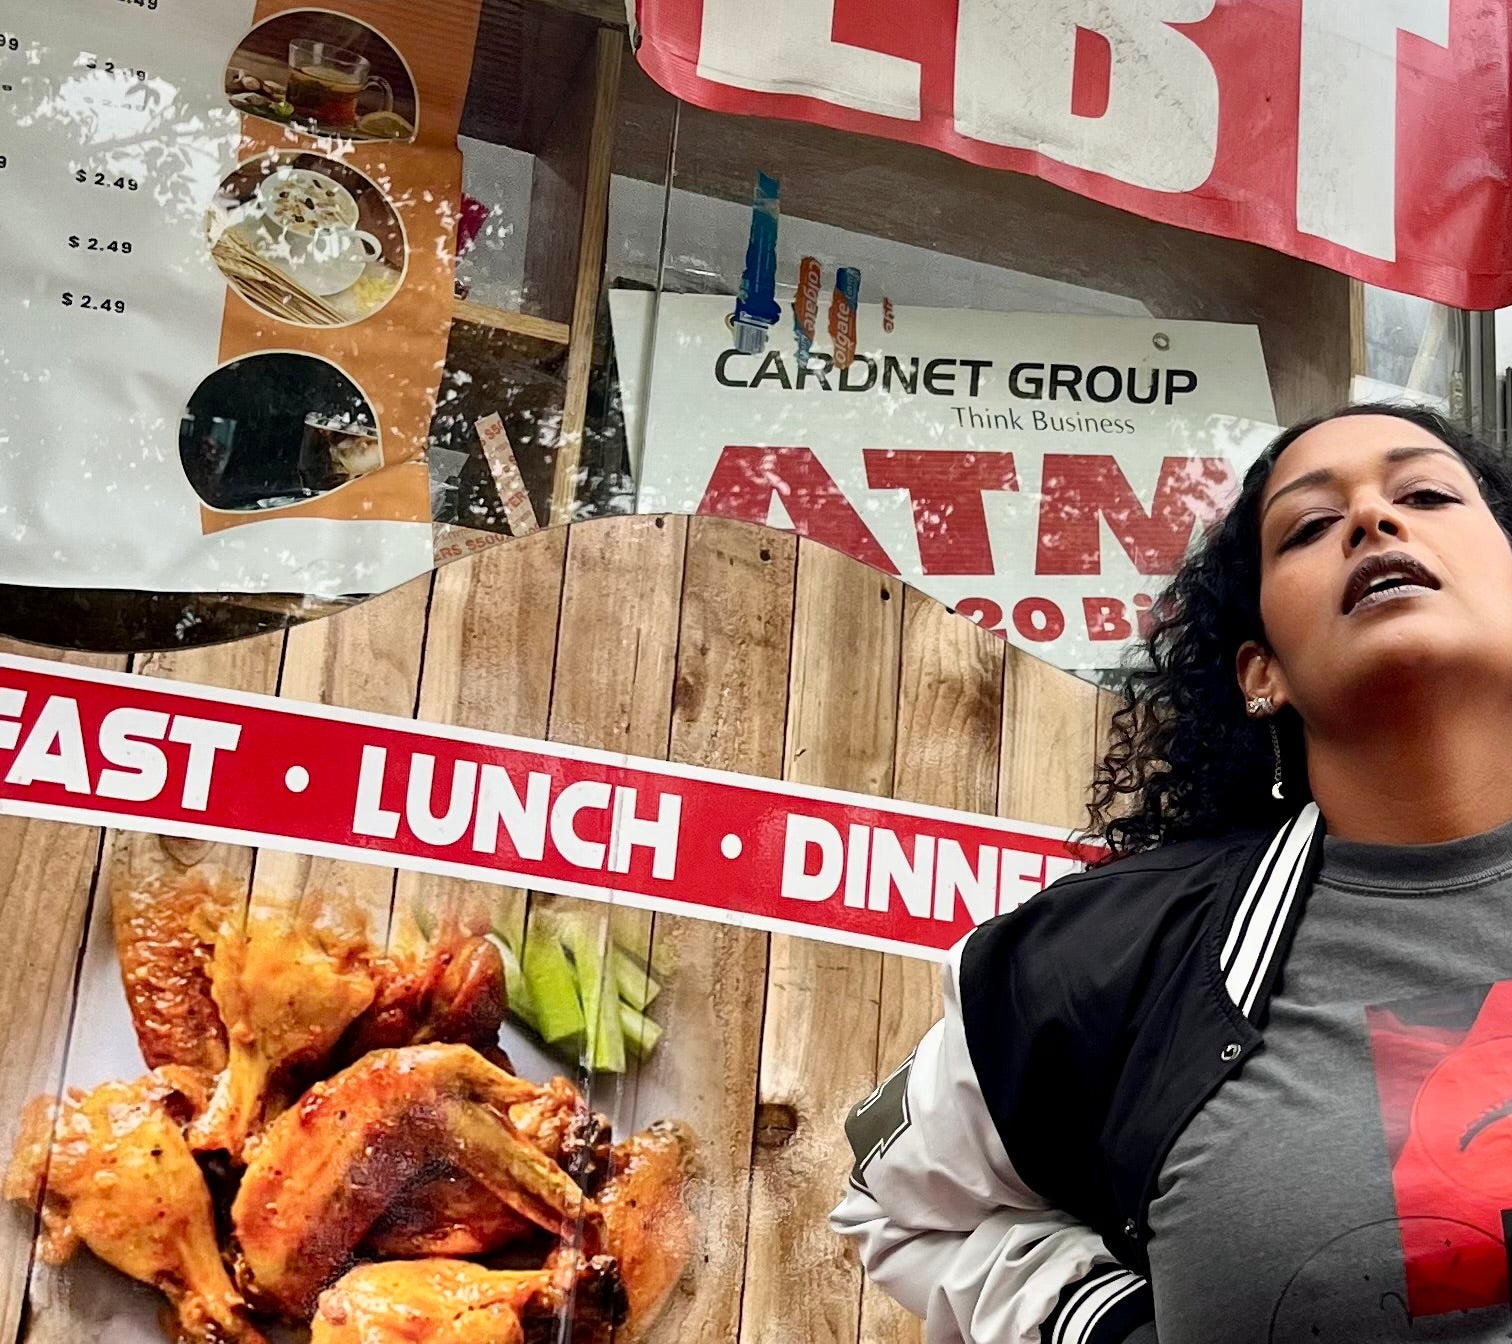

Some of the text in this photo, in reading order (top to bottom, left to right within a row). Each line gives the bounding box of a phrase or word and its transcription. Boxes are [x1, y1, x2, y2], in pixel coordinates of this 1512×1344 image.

[94, 173, 138, 191] 2.49
[87, 238, 132, 254] 2.49
[80, 295, 125, 313] 2.49
[802, 259, 822, 332] Colgate
[714, 347, 992, 399] CARDNET
[1009, 362, 1198, 406] GROUP
[951, 405, 1136, 436] Think Business
[352, 743, 682, 881] LUNCH
